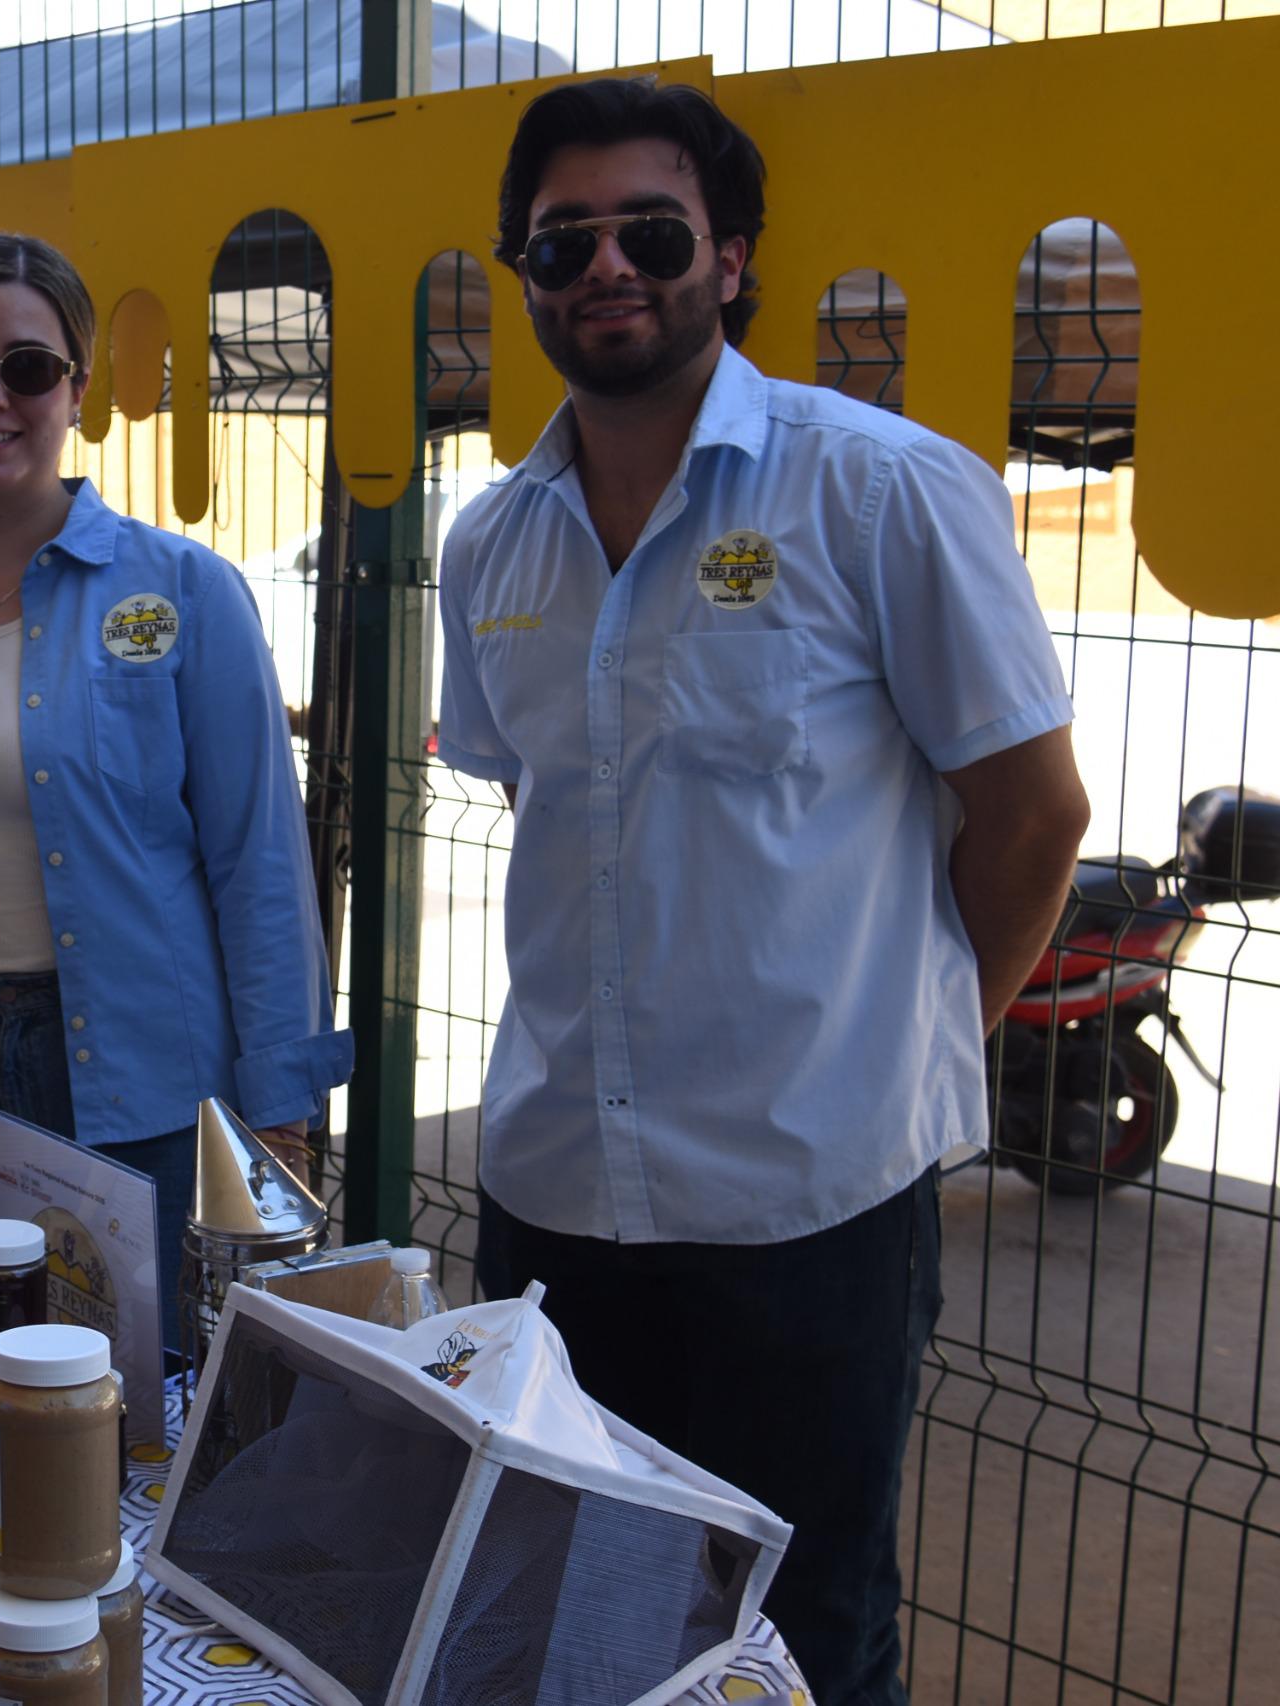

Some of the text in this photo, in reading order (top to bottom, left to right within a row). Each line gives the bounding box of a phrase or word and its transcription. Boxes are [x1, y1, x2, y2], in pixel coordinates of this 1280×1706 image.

[701, 565, 772, 578] TRES REYNAS
[105, 622, 175, 638] TRES REYNAS
[62, 1285, 114, 1331] REYNAS
